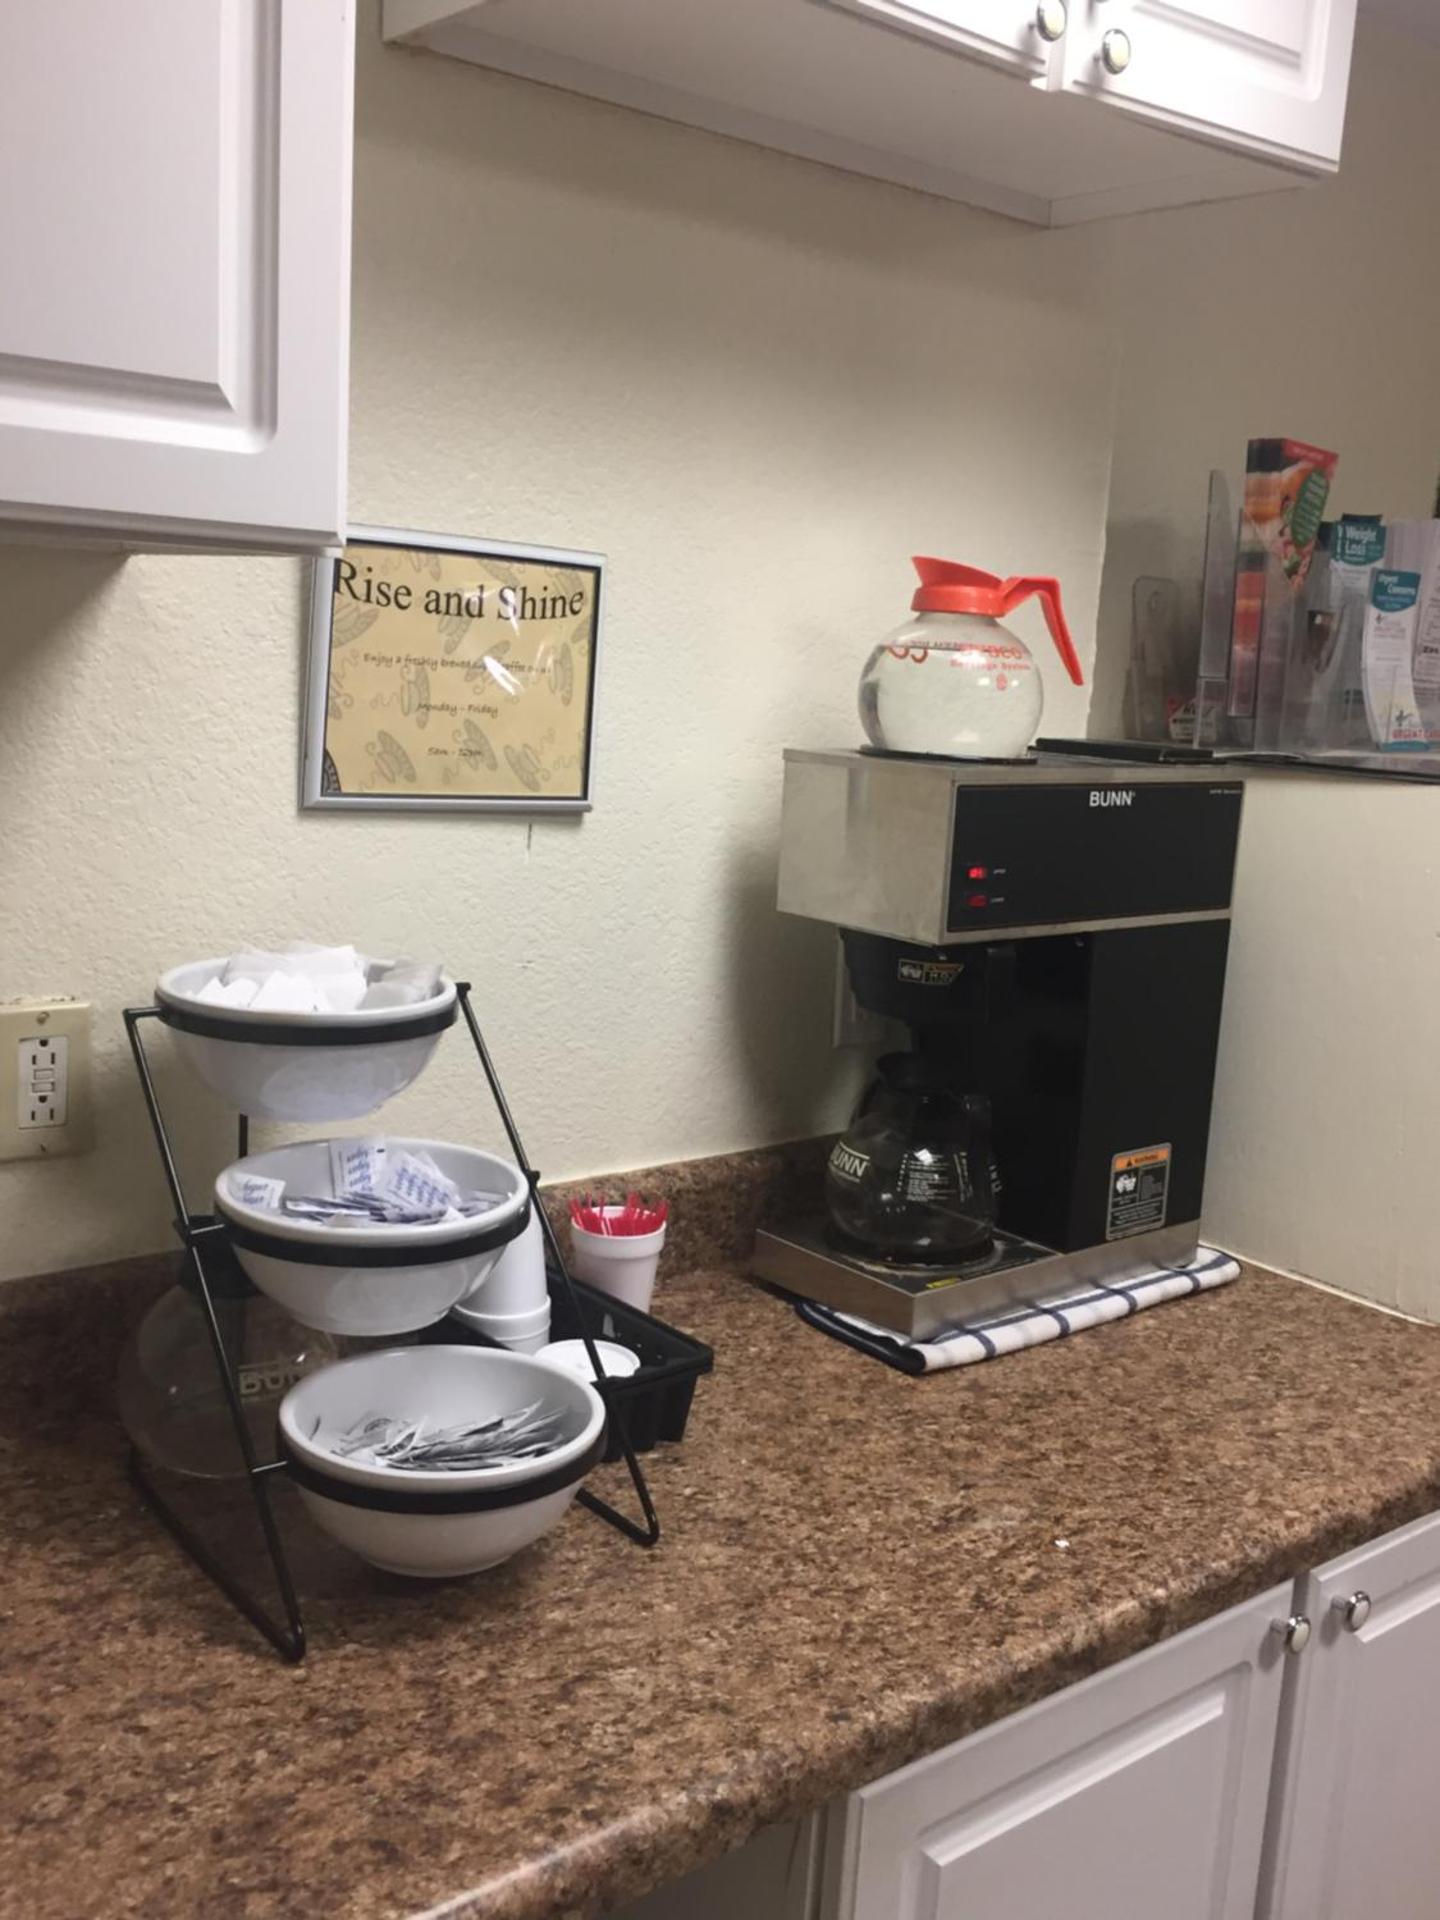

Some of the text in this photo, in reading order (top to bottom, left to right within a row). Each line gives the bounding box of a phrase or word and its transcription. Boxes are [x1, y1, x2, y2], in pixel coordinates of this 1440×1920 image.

[334, 557, 585, 621] Rise and Shine
[415, 702, 458, 717] Monday
[468, 703, 498, 719] Friday
[1089, 790, 1132, 807] BUNN
